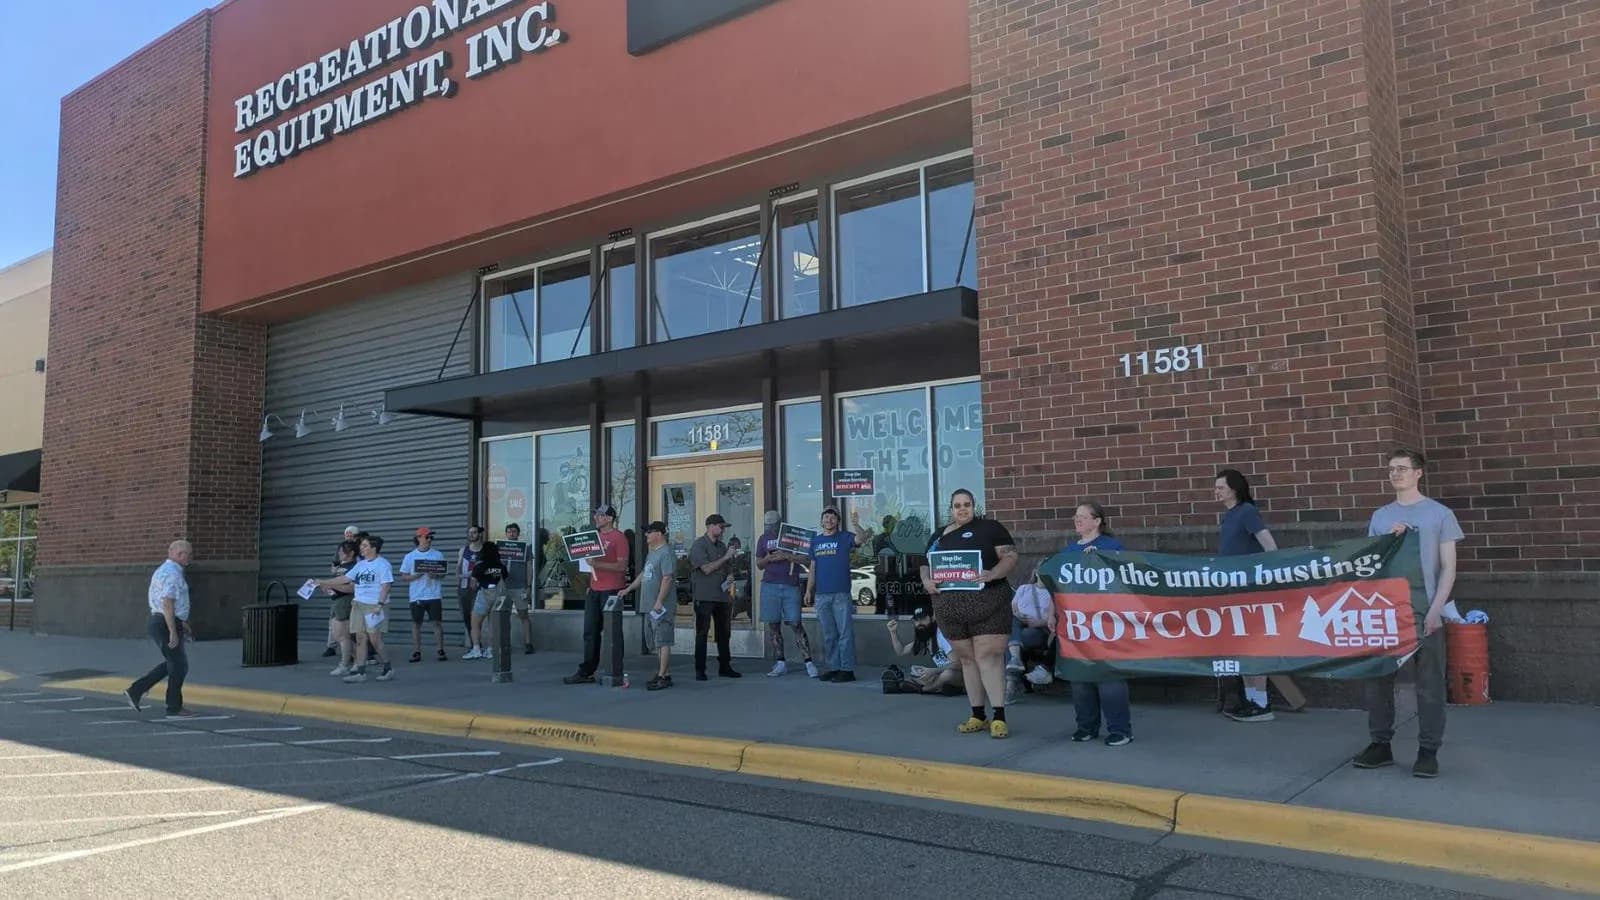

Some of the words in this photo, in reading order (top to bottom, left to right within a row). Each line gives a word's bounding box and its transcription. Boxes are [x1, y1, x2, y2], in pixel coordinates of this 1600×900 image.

[234, 0, 513, 132] RECREATIONA
[233, 51, 450, 178] EQUIPMENT,
[465, 1, 561, 78] INC.
[1119, 343, 1204, 377] 11581
[688, 423, 729, 444] 11581
[847, 402, 982, 440] WELCME
[862, 449, 911, 472] THE
[1058, 562, 1115, 591] Stop
[1119, 562, 1160, 587] the
[1163, 566, 1248, 588] union
[1254, 553, 1382, 586] busting:
[1064, 602, 1285, 642] BOYCOTT
[1332, 608, 1399, 635] REI
[1212, 659, 1240, 673] REI
